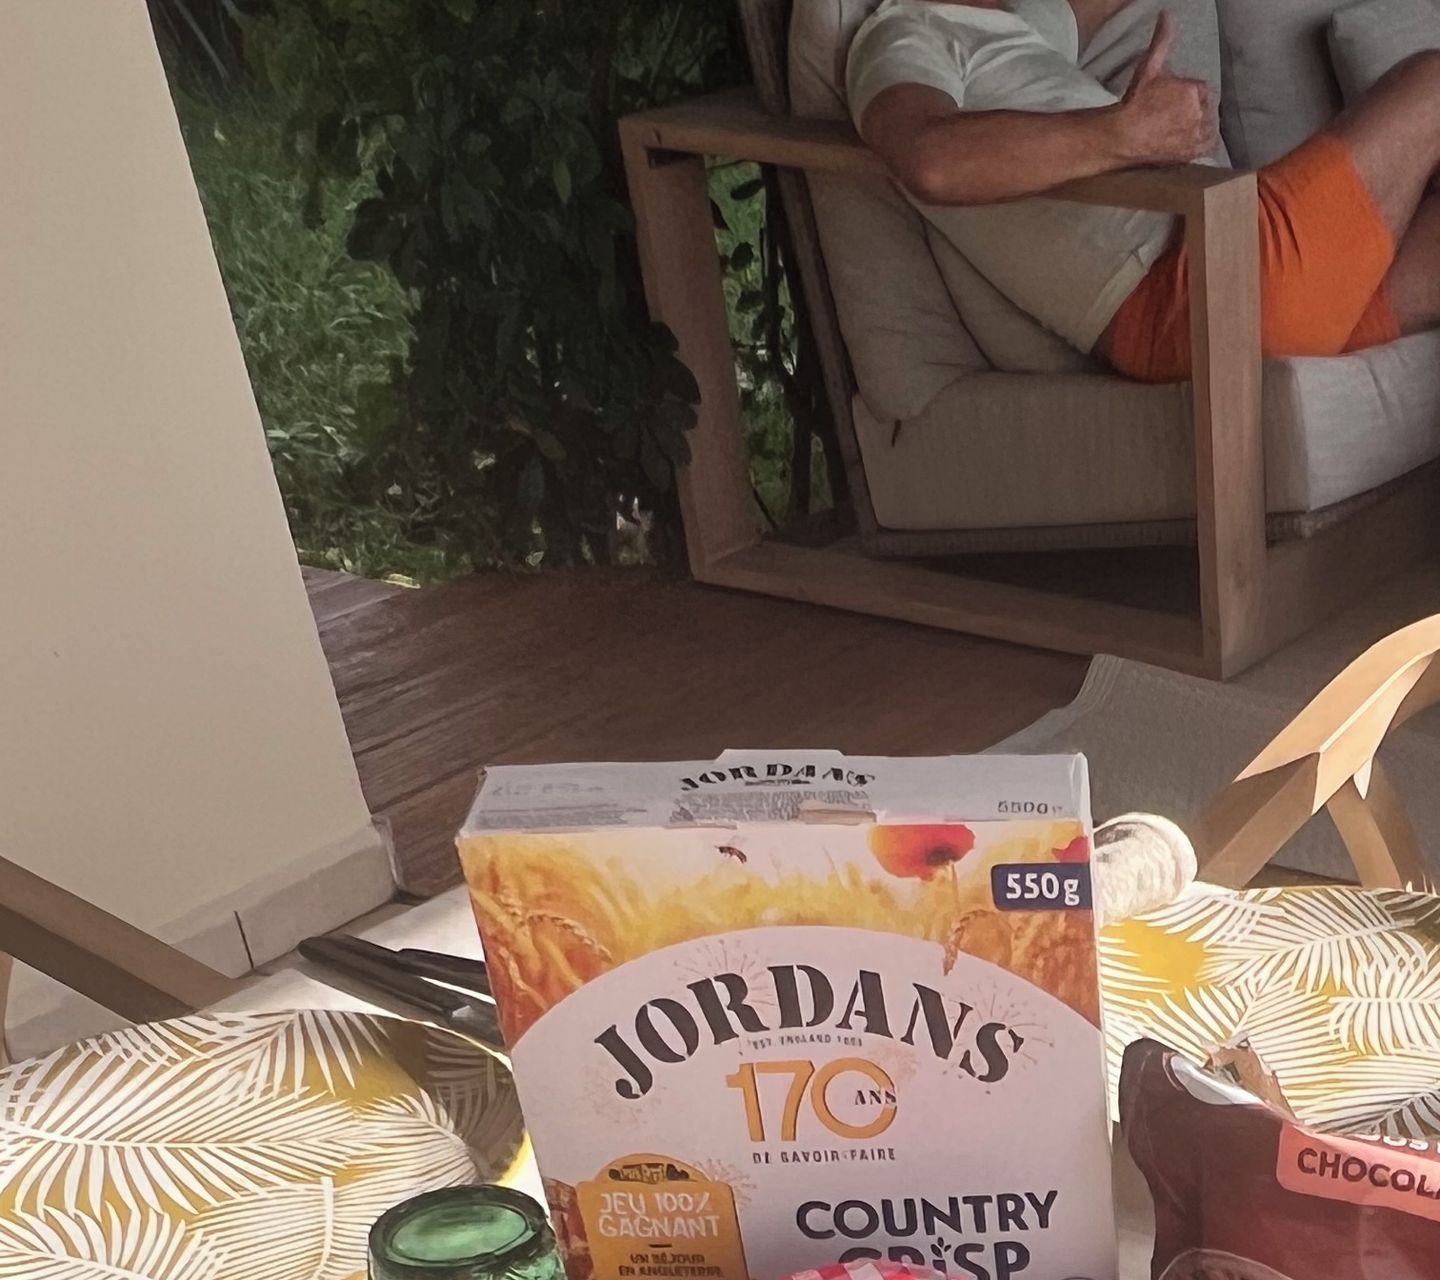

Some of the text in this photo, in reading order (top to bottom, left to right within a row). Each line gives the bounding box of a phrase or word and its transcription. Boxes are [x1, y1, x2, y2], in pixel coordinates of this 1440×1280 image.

[1005, 872, 1080, 906] 550g
[594, 964, 1025, 1099] JORDANS
[725, 1056, 898, 1143] 170
[854, 1089, 898, 1106] ANS
[600, 1192, 647, 1215] JEU
[796, 1190, 1059, 1240] COUNTRY
[598, 1215, 721, 1239] GAGNANT
